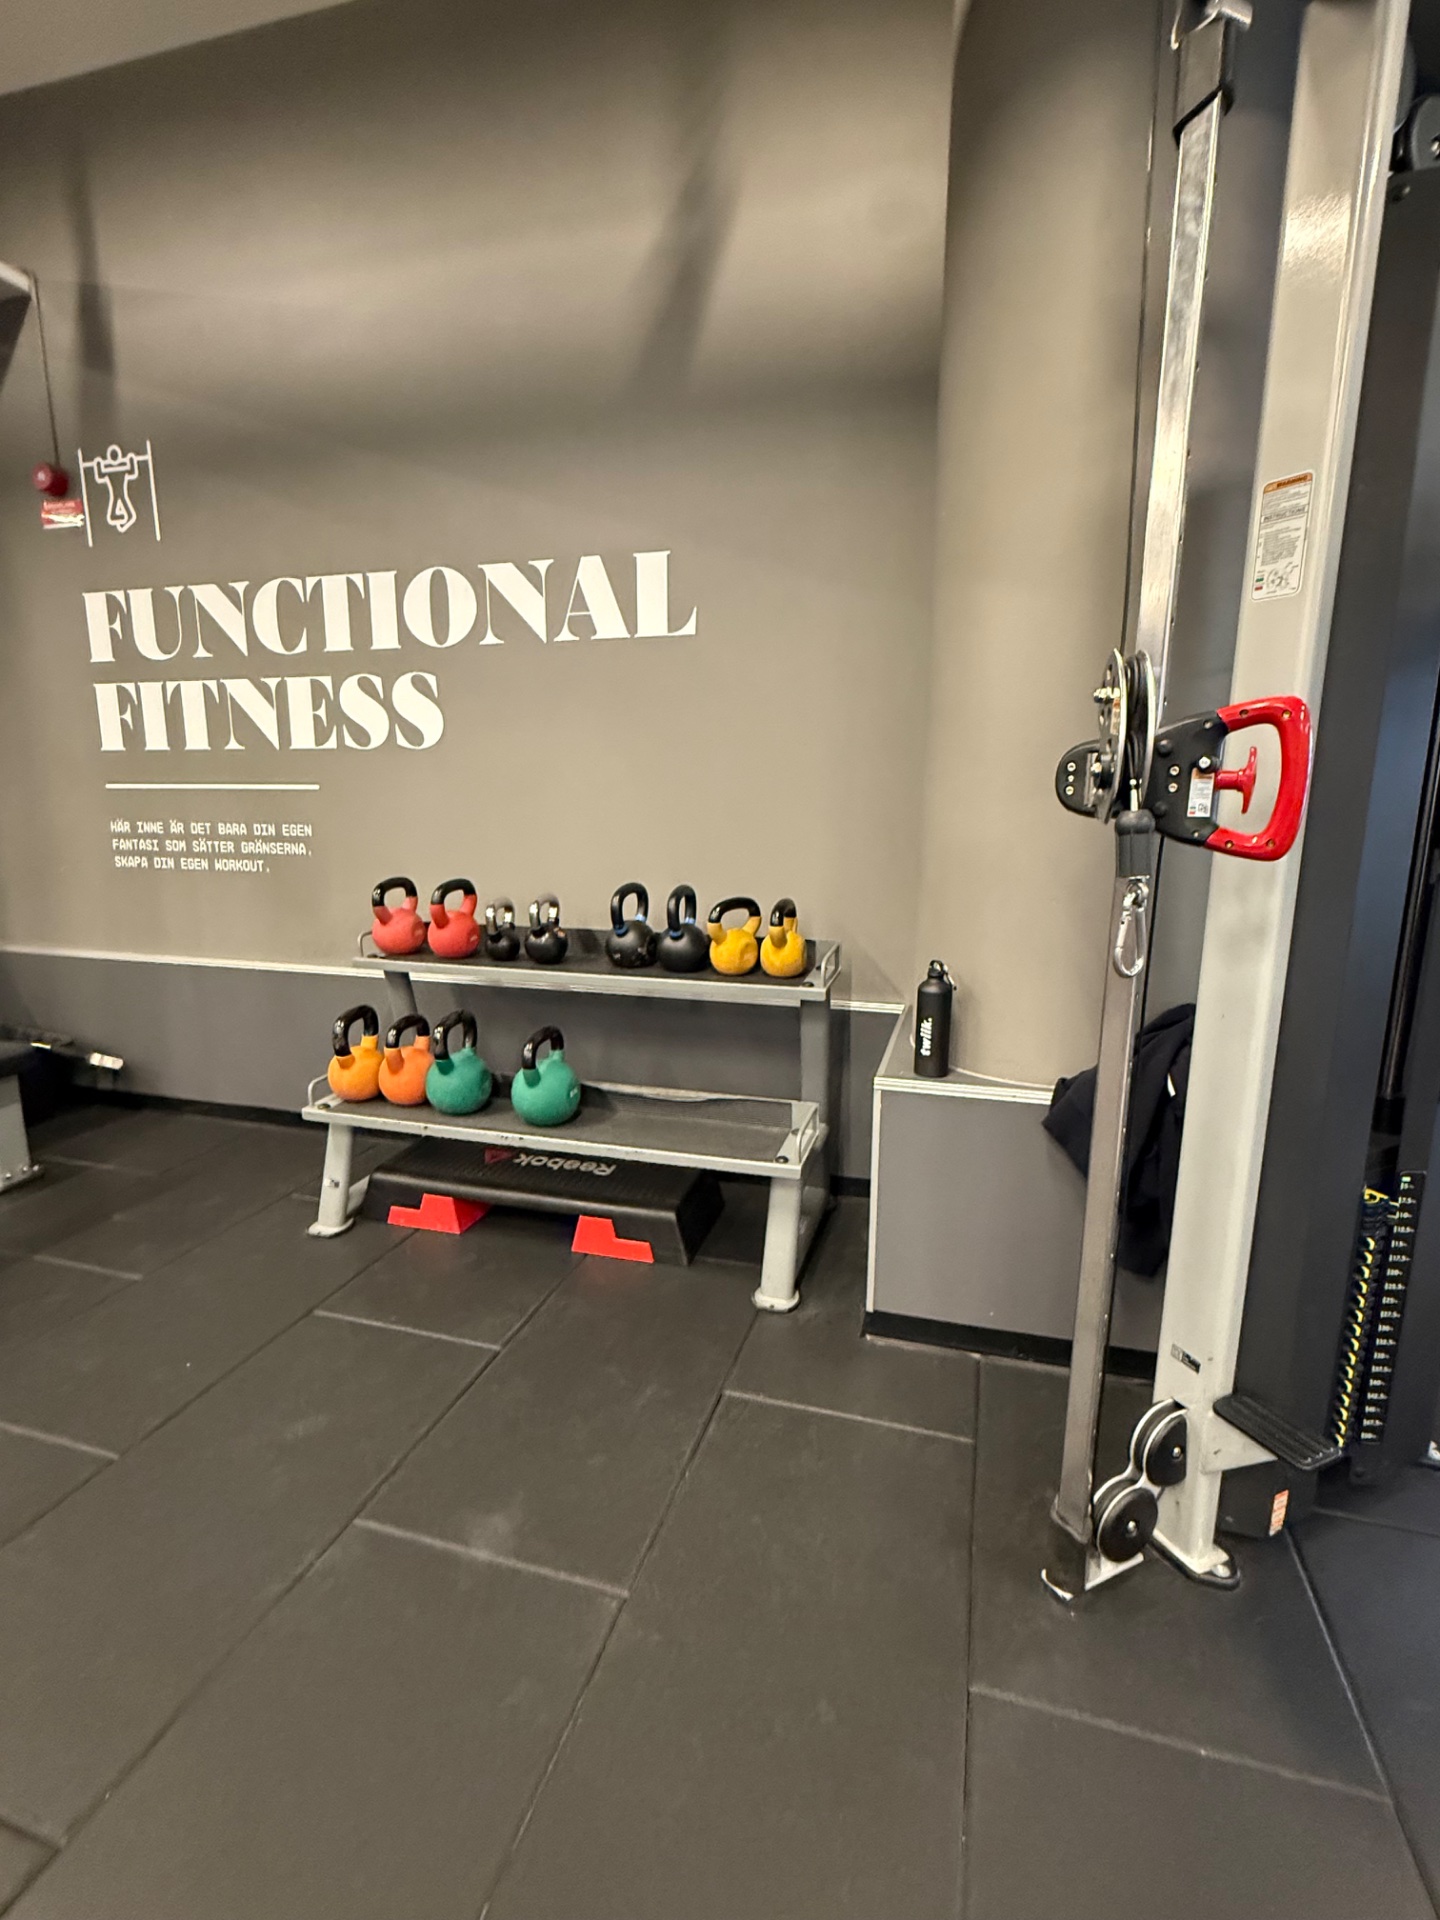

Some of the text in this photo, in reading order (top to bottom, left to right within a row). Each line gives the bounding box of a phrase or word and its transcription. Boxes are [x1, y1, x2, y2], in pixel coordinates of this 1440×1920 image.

[82, 550, 697, 662] FUNCTIONAL
[93, 671, 445, 751] FITNESS
[110, 818, 313, 837] HÄR INNE ÄR DET BARA DIN EGEN
[112, 837, 312, 856] FANTASI SOM SÄTTER GRÄNSERNA.
[114, 855, 270, 873] SKAPA DIN EGEN WORKOUT.
[513, 1153, 617, 1176] Reebok
